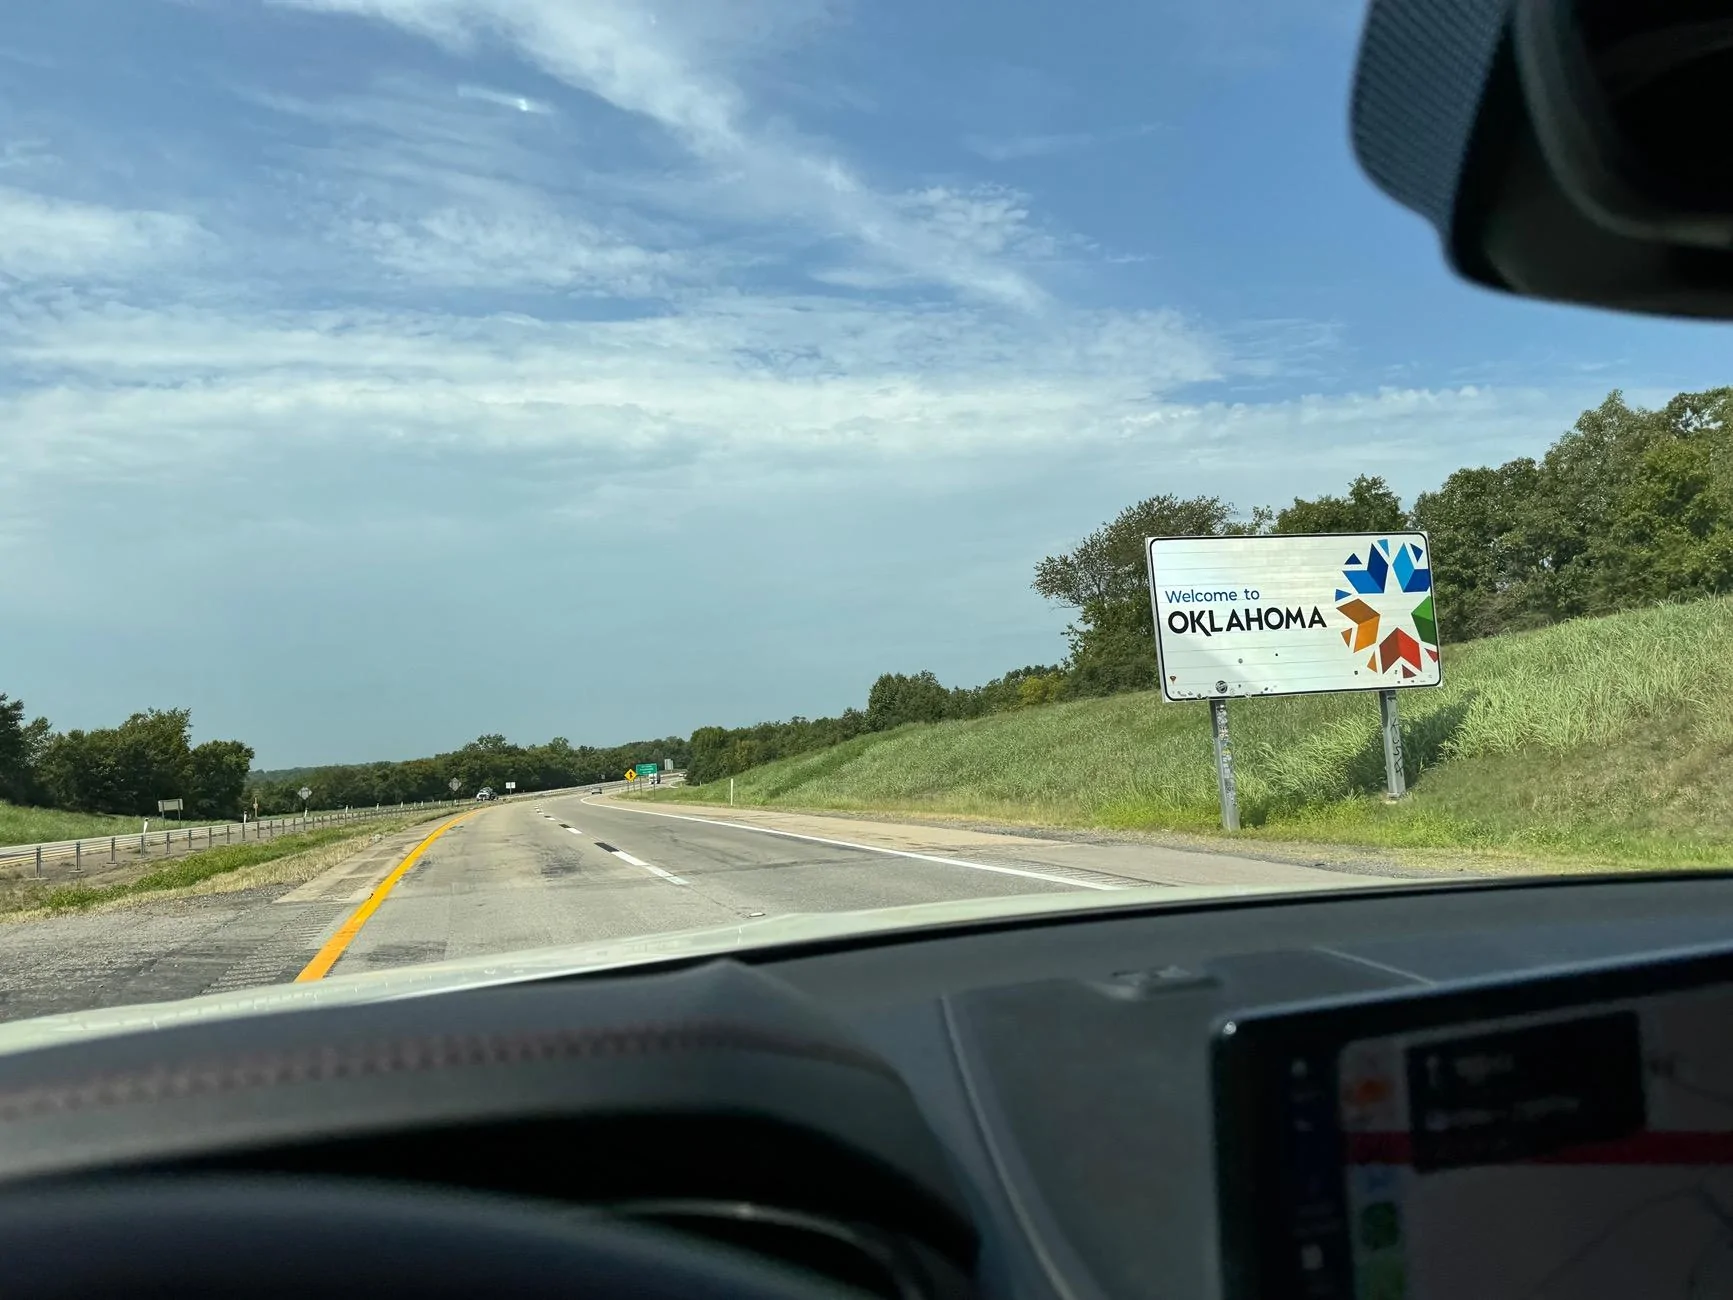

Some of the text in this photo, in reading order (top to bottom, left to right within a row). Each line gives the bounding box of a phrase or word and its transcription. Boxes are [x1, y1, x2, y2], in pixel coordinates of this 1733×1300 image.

[1165, 588, 1260, 604] Welcome to
[1167, 606, 1327, 637] OKLAHOMA
